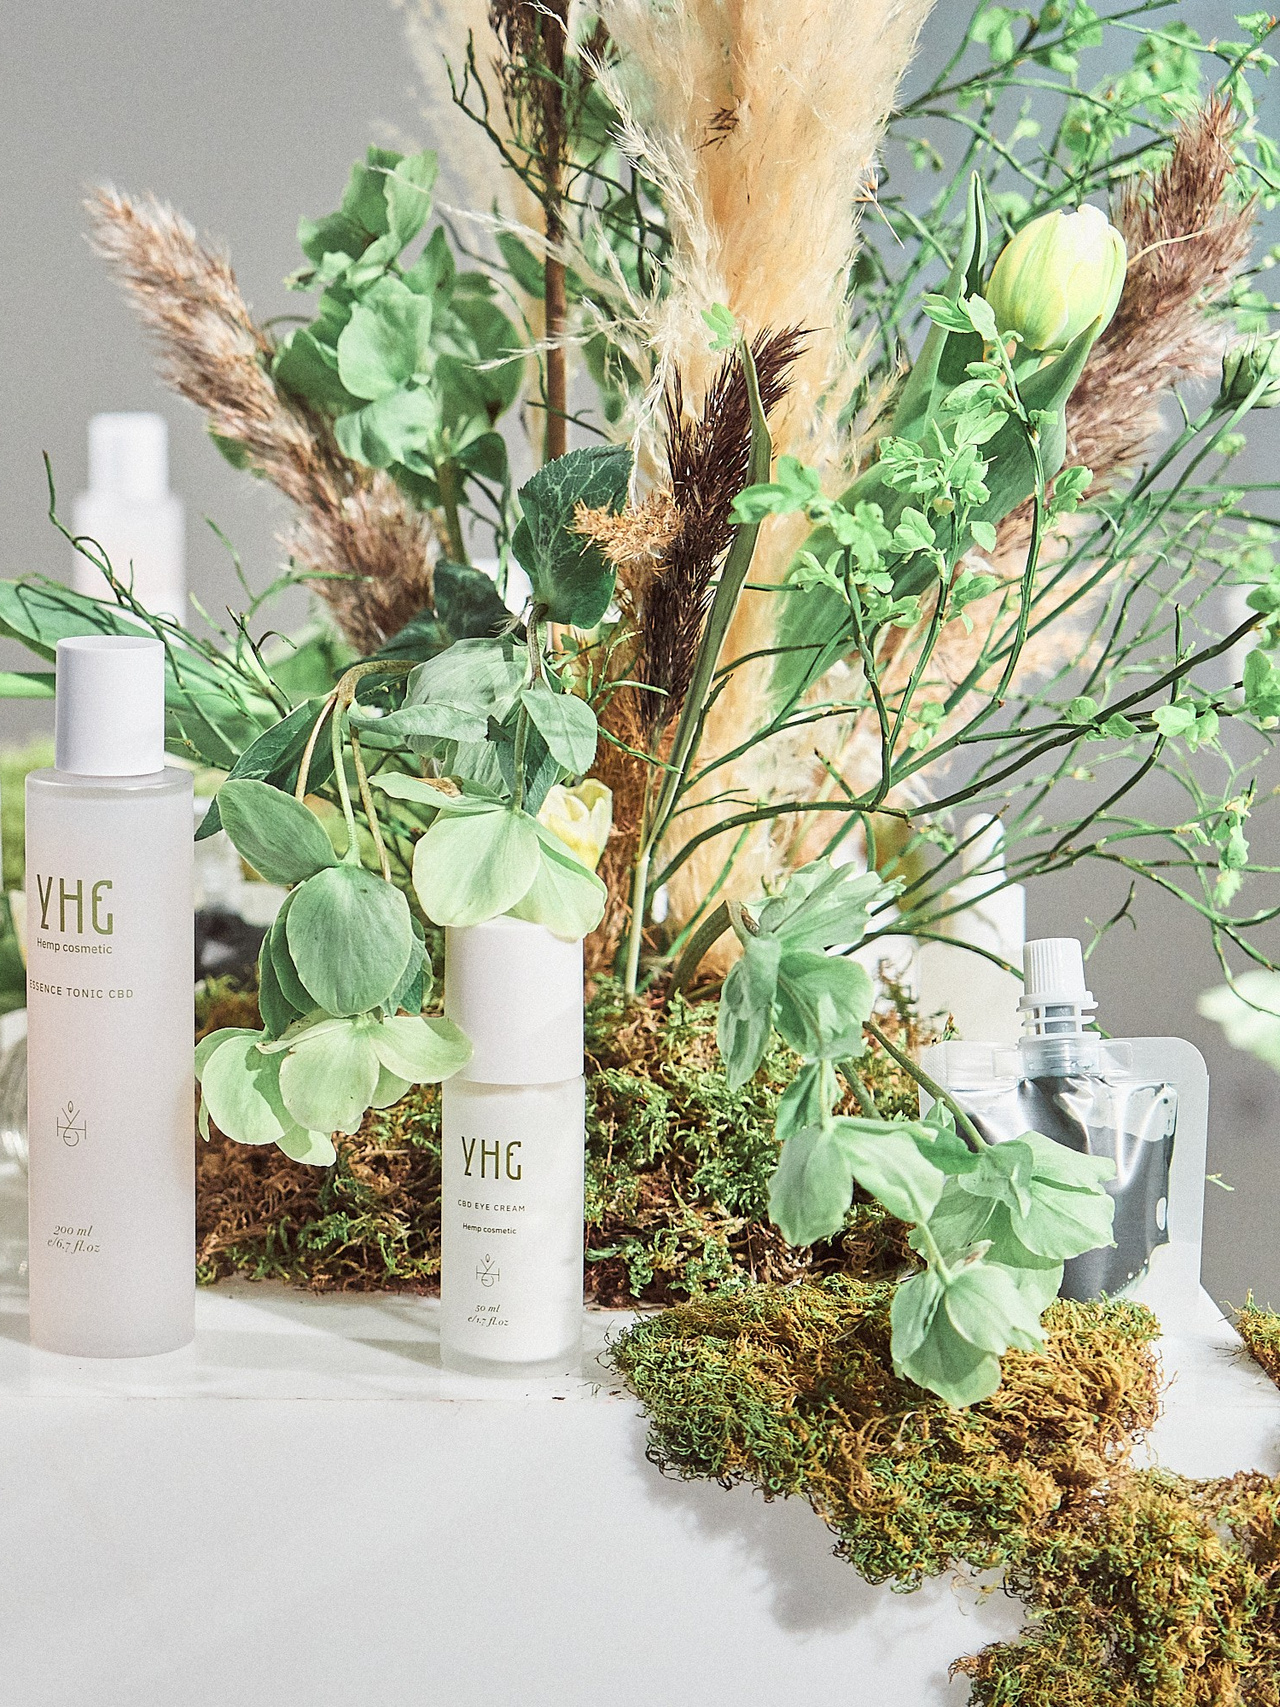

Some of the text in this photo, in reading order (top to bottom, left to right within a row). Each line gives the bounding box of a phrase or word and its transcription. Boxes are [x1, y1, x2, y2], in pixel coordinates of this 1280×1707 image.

[36, 874, 114, 935] YHG
[36, 937, 113, 955] Hemp cosmetic
[29, 979, 134, 999] ESSENCE TONIC CBD
[461, 1136, 522, 1181] YHG
[457, 1199, 526, 1212] CBD EYE CREAM
[53, 1225, 94, 1237] 200 ml
[462, 1222, 517, 1235] Hemp cosmetic
[71, 1240, 101, 1255] fl.oz
[475, 1304, 501, 1313] 50 ml
